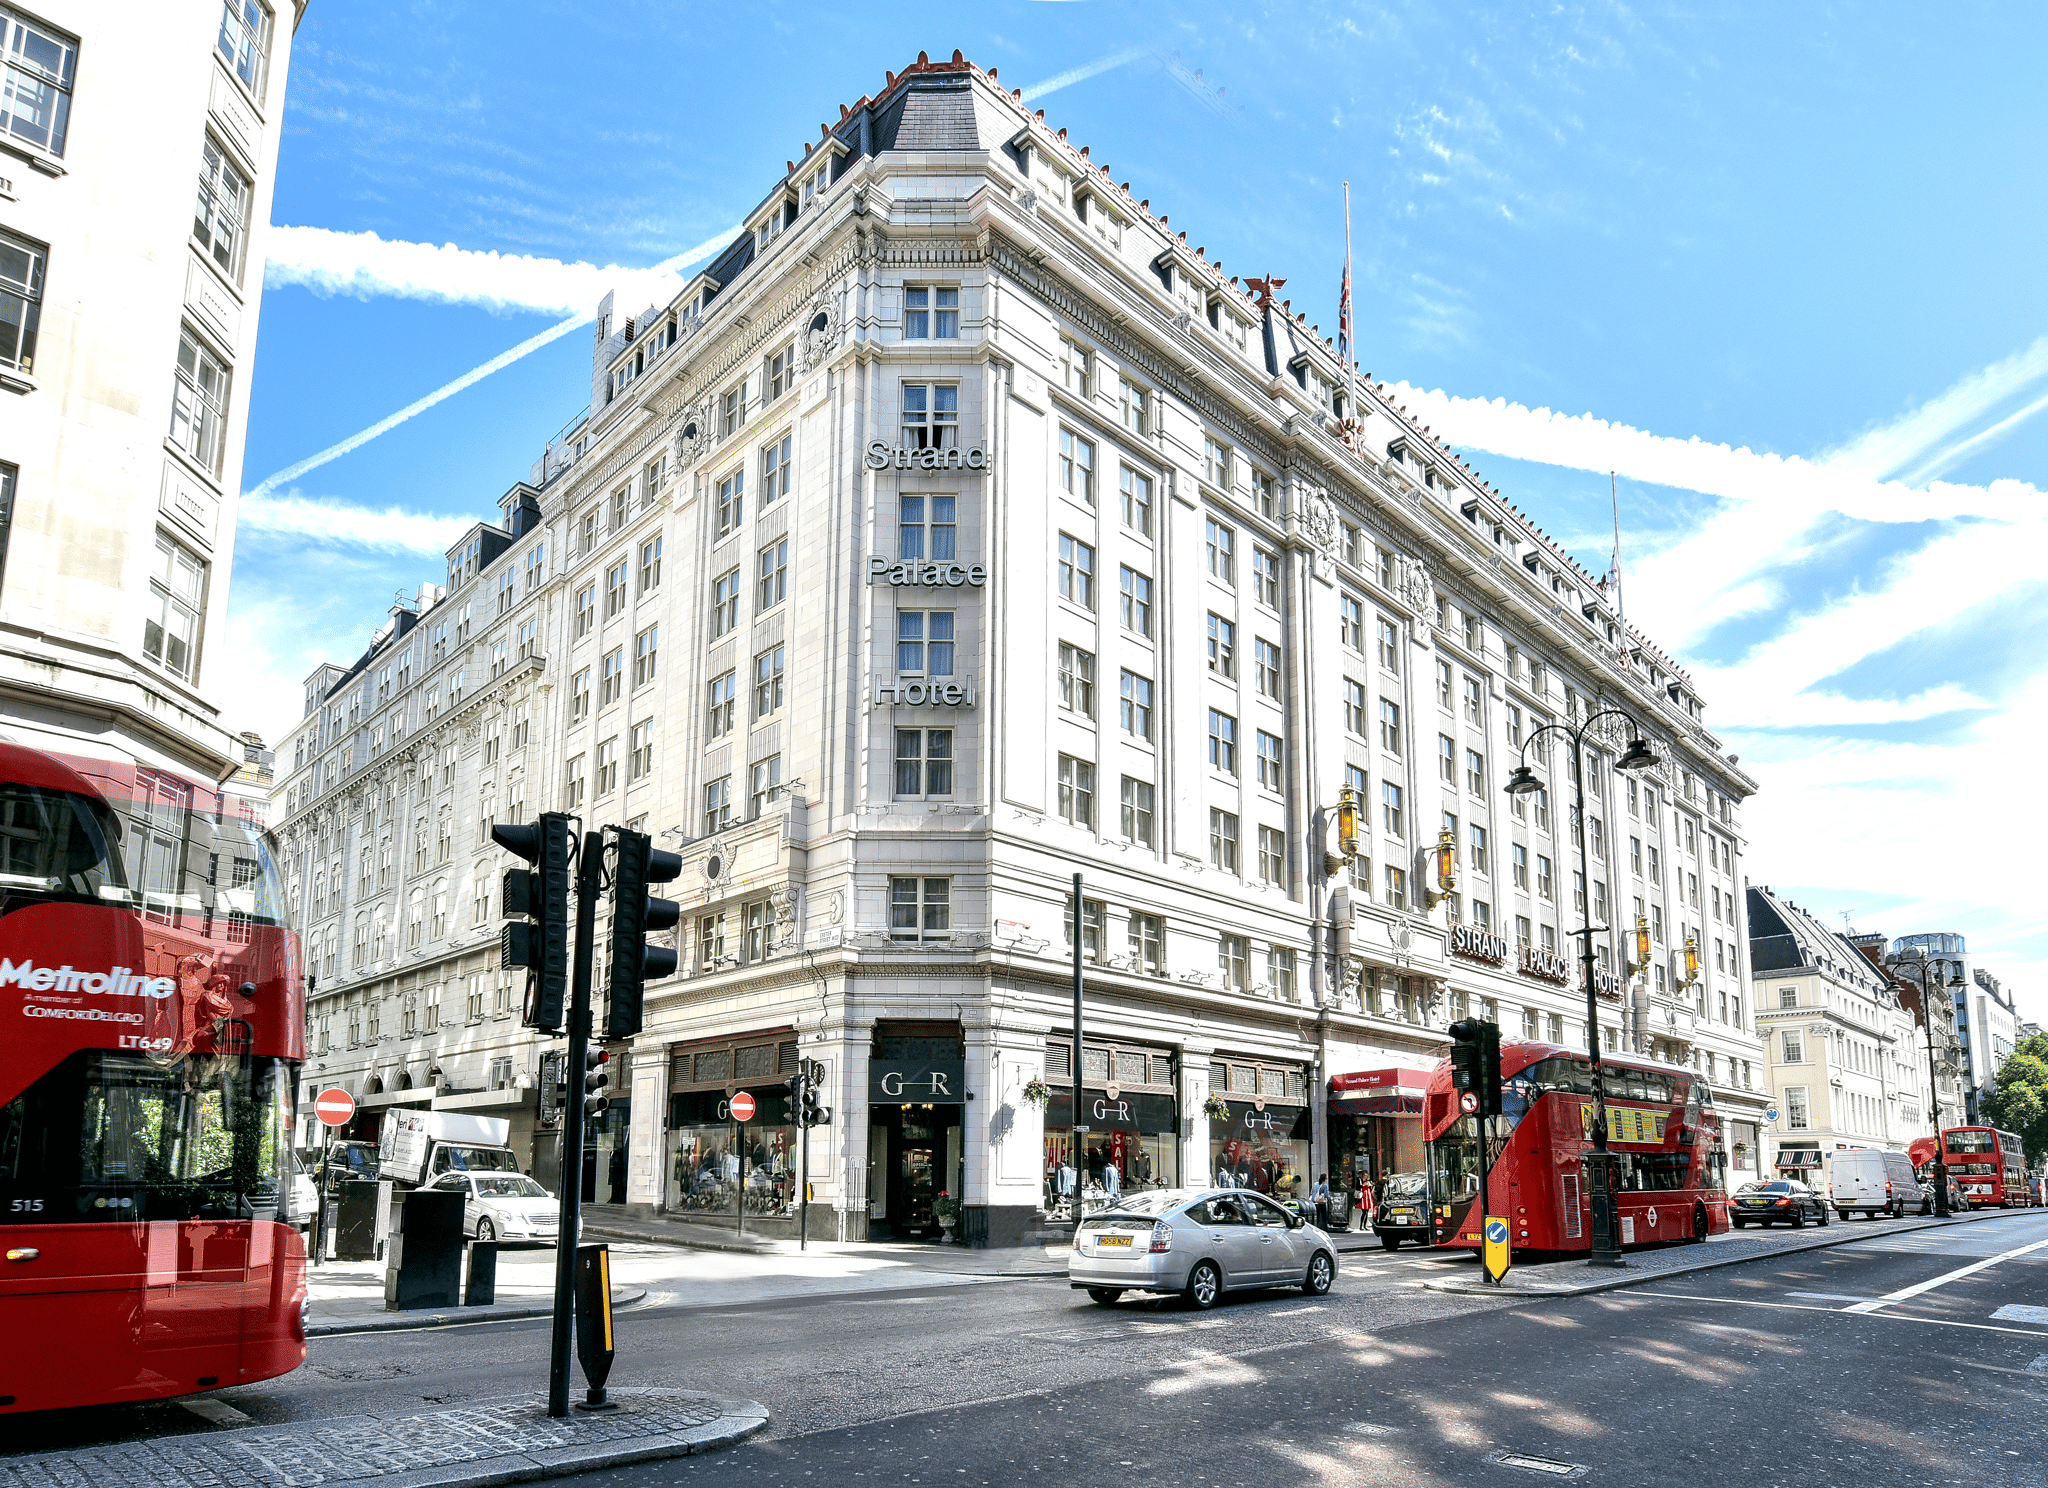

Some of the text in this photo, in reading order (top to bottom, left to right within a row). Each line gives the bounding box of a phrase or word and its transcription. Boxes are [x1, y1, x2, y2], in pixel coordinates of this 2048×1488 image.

[865, 439, 988, 471] Strand
[866, 555, 988, 587] Palace
[874, 673, 974, 706] Hotel
[1454, 925, 1624, 994] STRAND PALACE HOTEL
[0, 957, 177, 999] Metroline
[118, 1035, 173, 1050] LT649
[10, 1199, 44, 1212] 515
